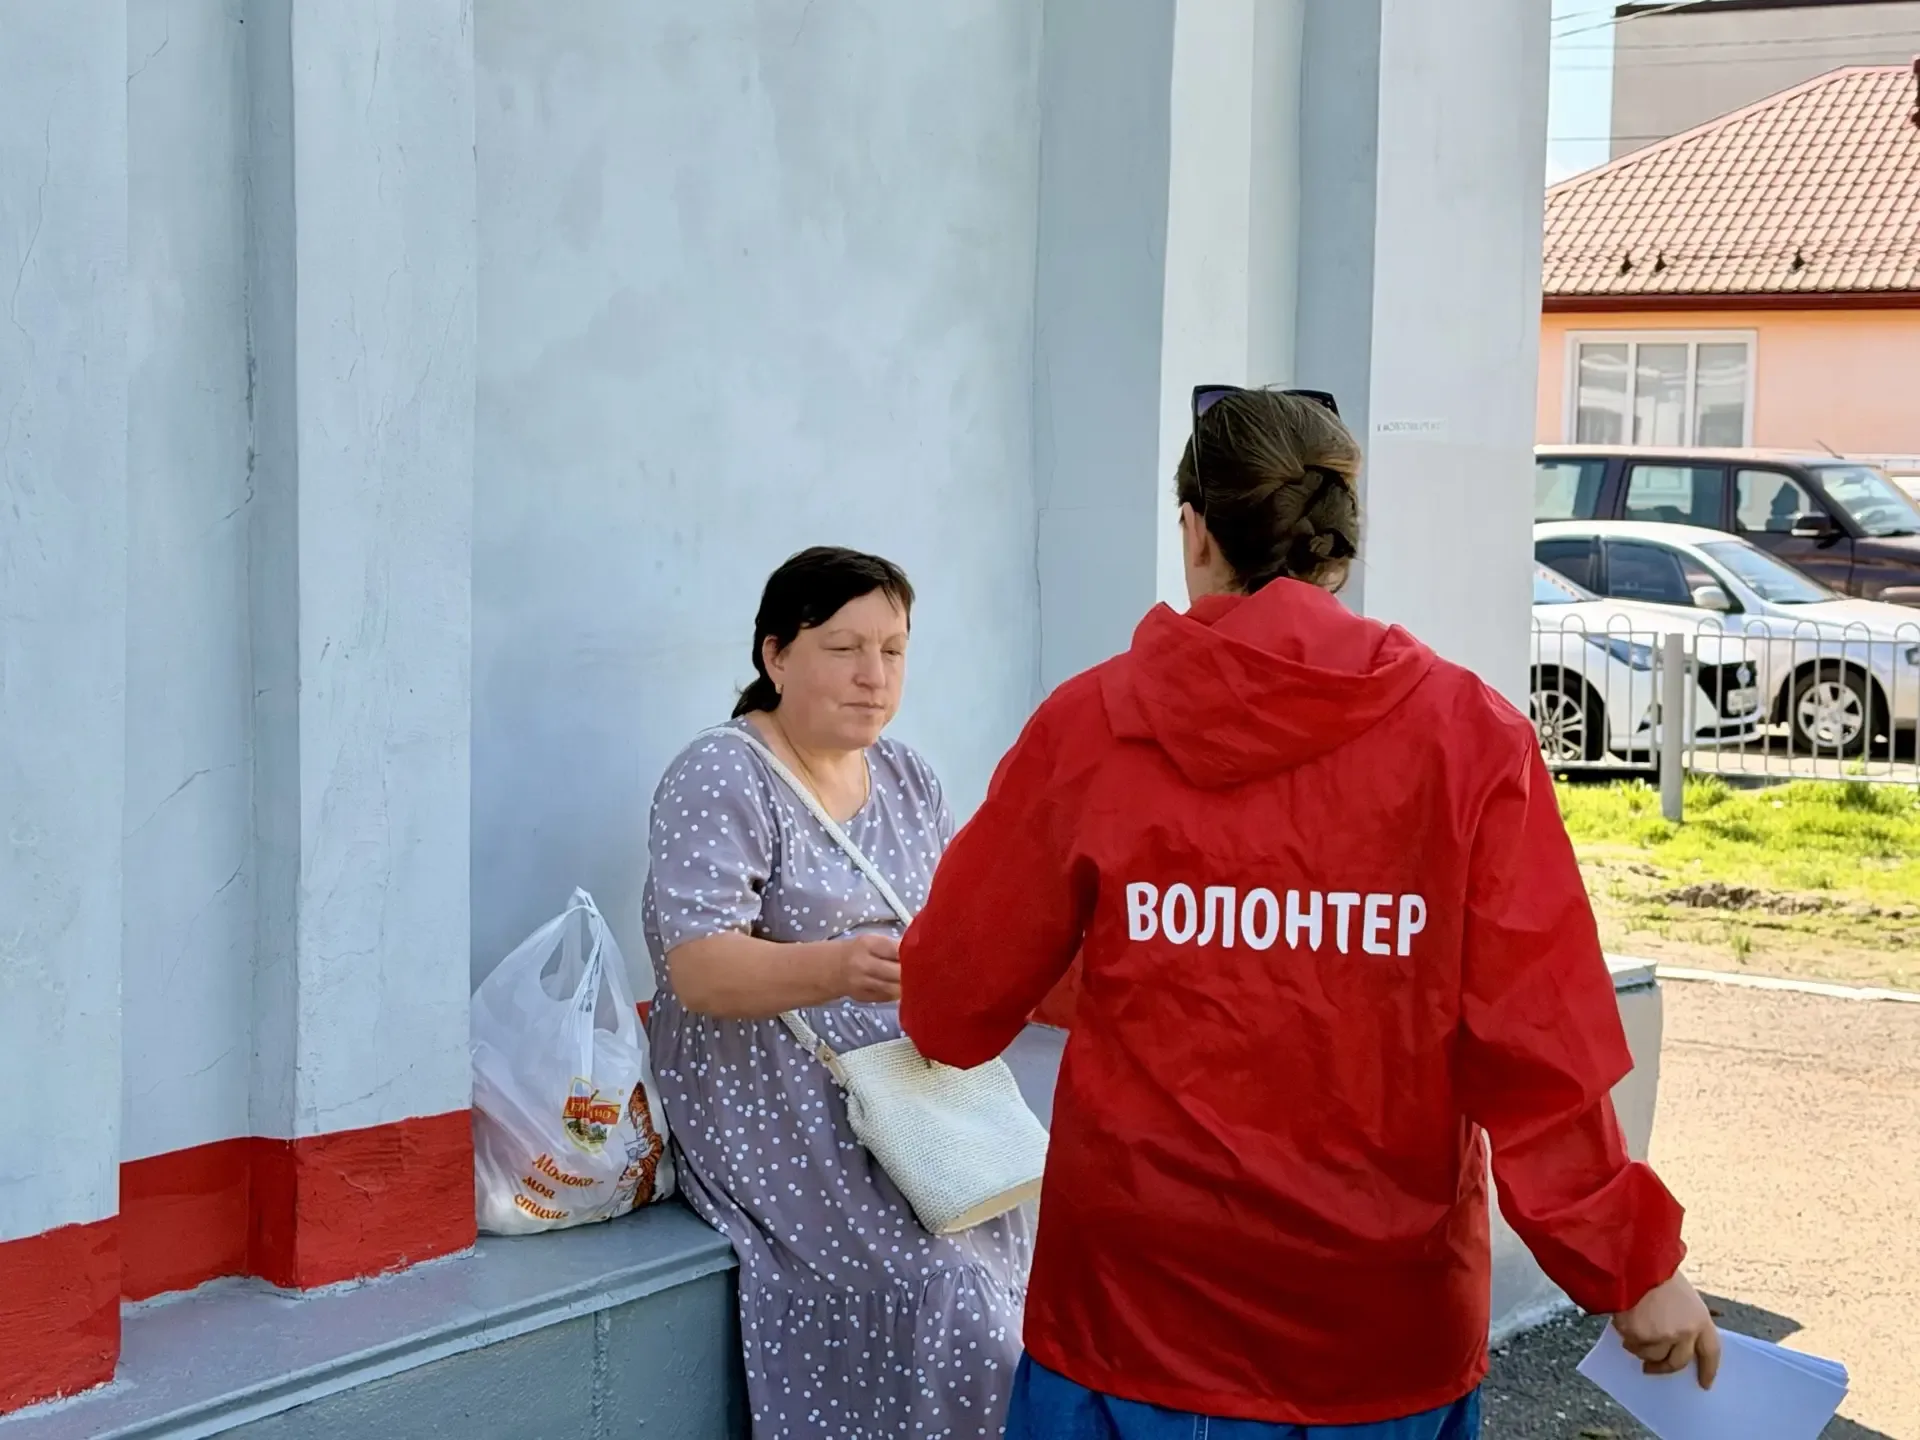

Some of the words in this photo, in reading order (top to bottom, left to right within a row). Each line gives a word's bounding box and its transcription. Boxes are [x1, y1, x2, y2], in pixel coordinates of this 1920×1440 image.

[1126, 882, 1427, 956] ВОЛОНТЕР
[532, 1153, 594, 1187] Молоко
[522, 1176, 555, 1200] моя
